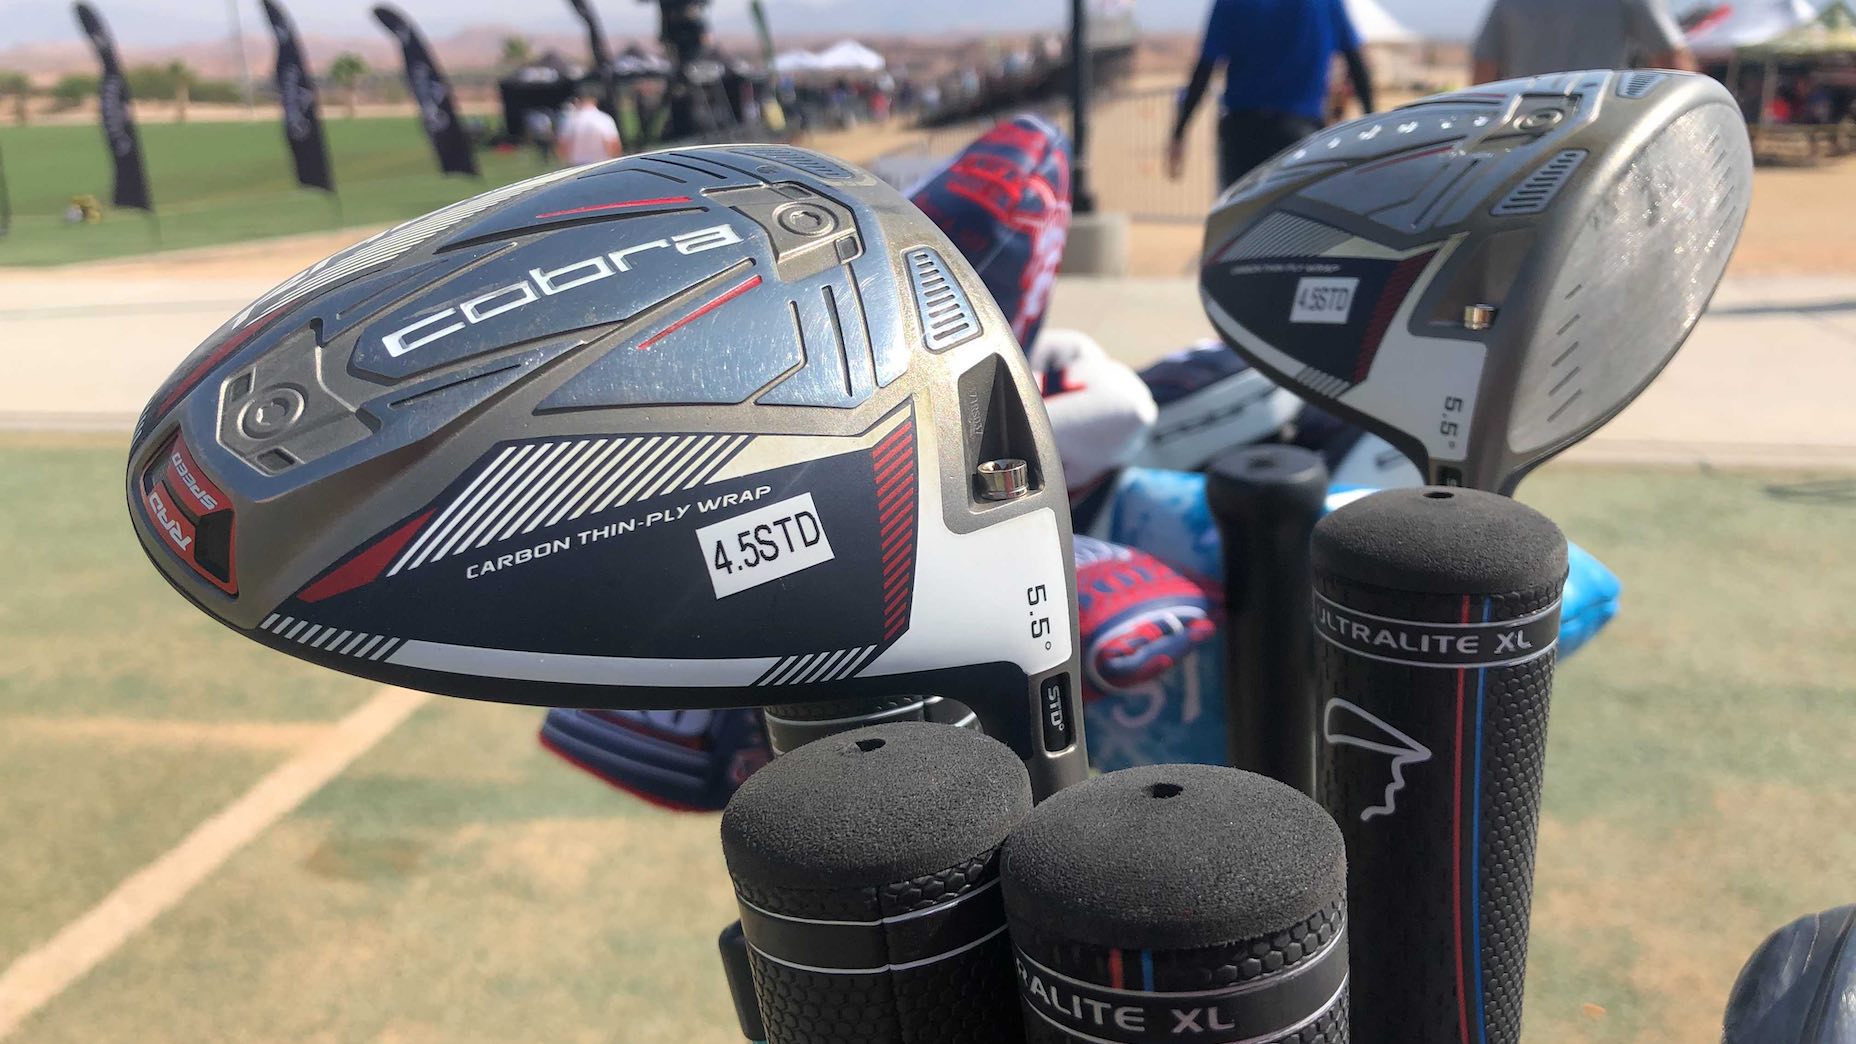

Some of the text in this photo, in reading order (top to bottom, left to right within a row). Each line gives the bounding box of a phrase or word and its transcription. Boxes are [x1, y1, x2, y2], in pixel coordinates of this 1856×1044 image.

[381, 223, 743, 358] cobra
[171, 452, 218, 510] SPEED
[149, 492, 192, 551] RAD
[466, 486, 772, 580] CARBON THIN-PLY WRAP
[714, 510, 821, 576] 4.5STD
[1494, 629, 1533, 655] XL
[1171, 1005, 1235, 1034] XL
